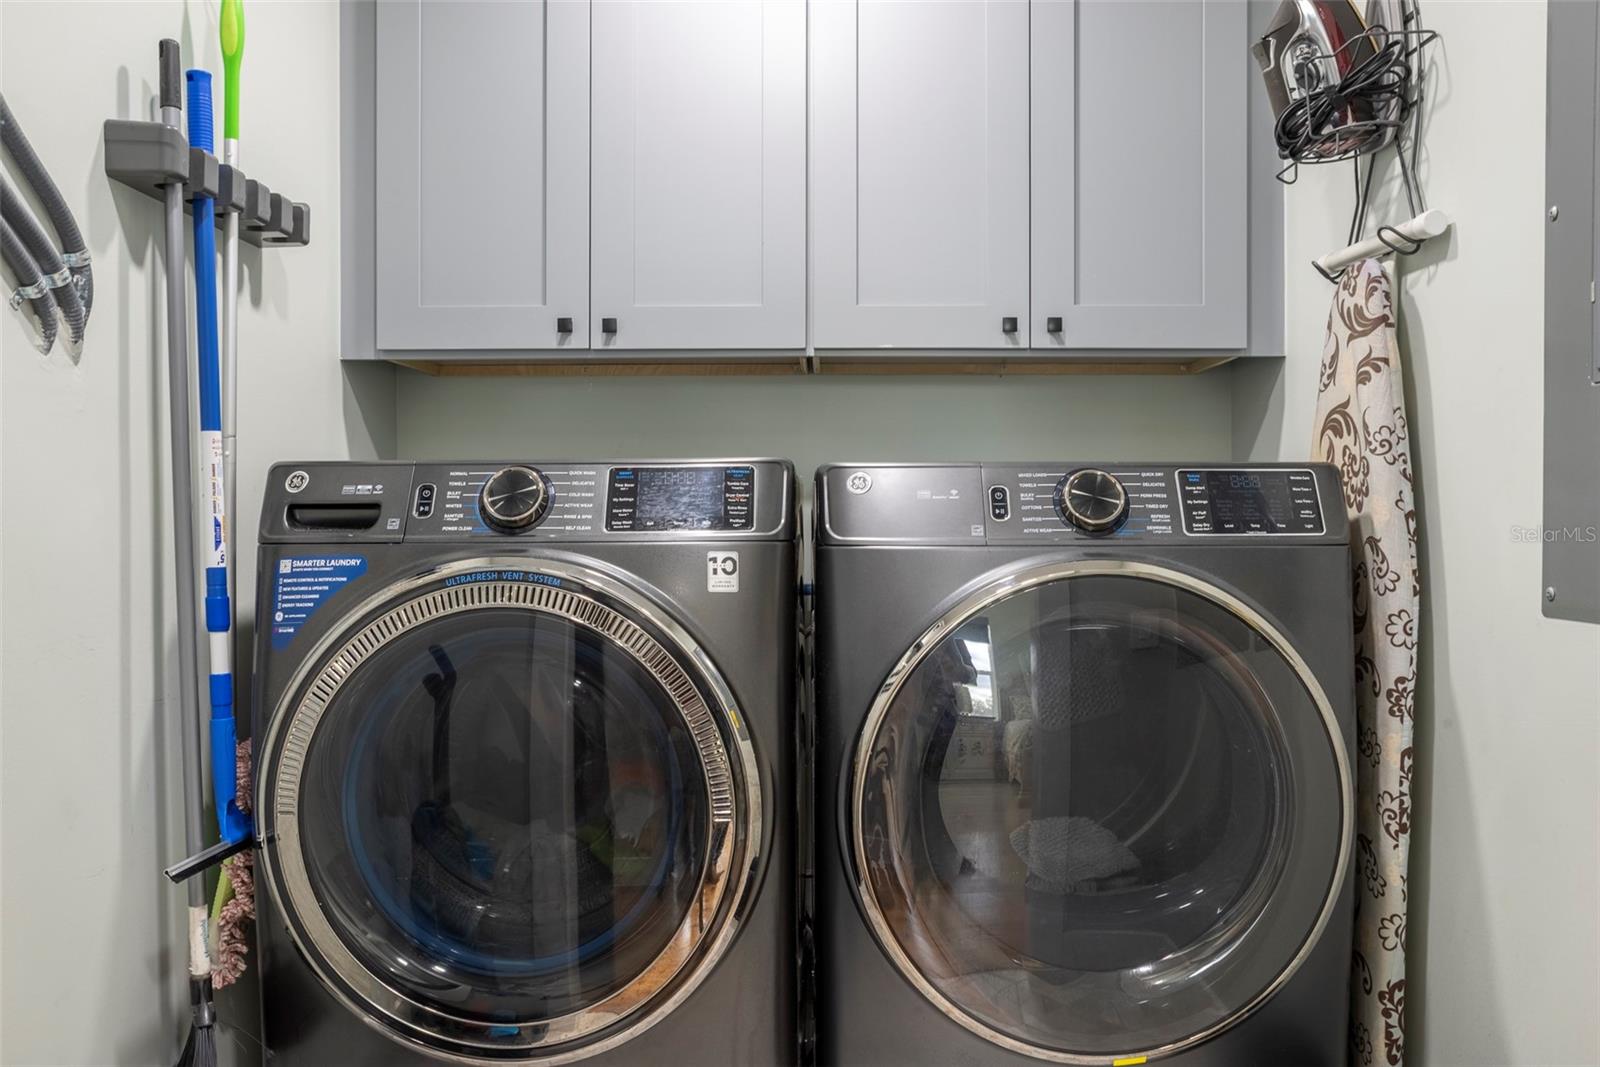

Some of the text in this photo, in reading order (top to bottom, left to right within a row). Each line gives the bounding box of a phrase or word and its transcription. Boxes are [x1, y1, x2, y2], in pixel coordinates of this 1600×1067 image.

[709, 556, 737, 576] 10
[446, 572, 561, 586] ULTRAFRESH VENT SYSTEM
